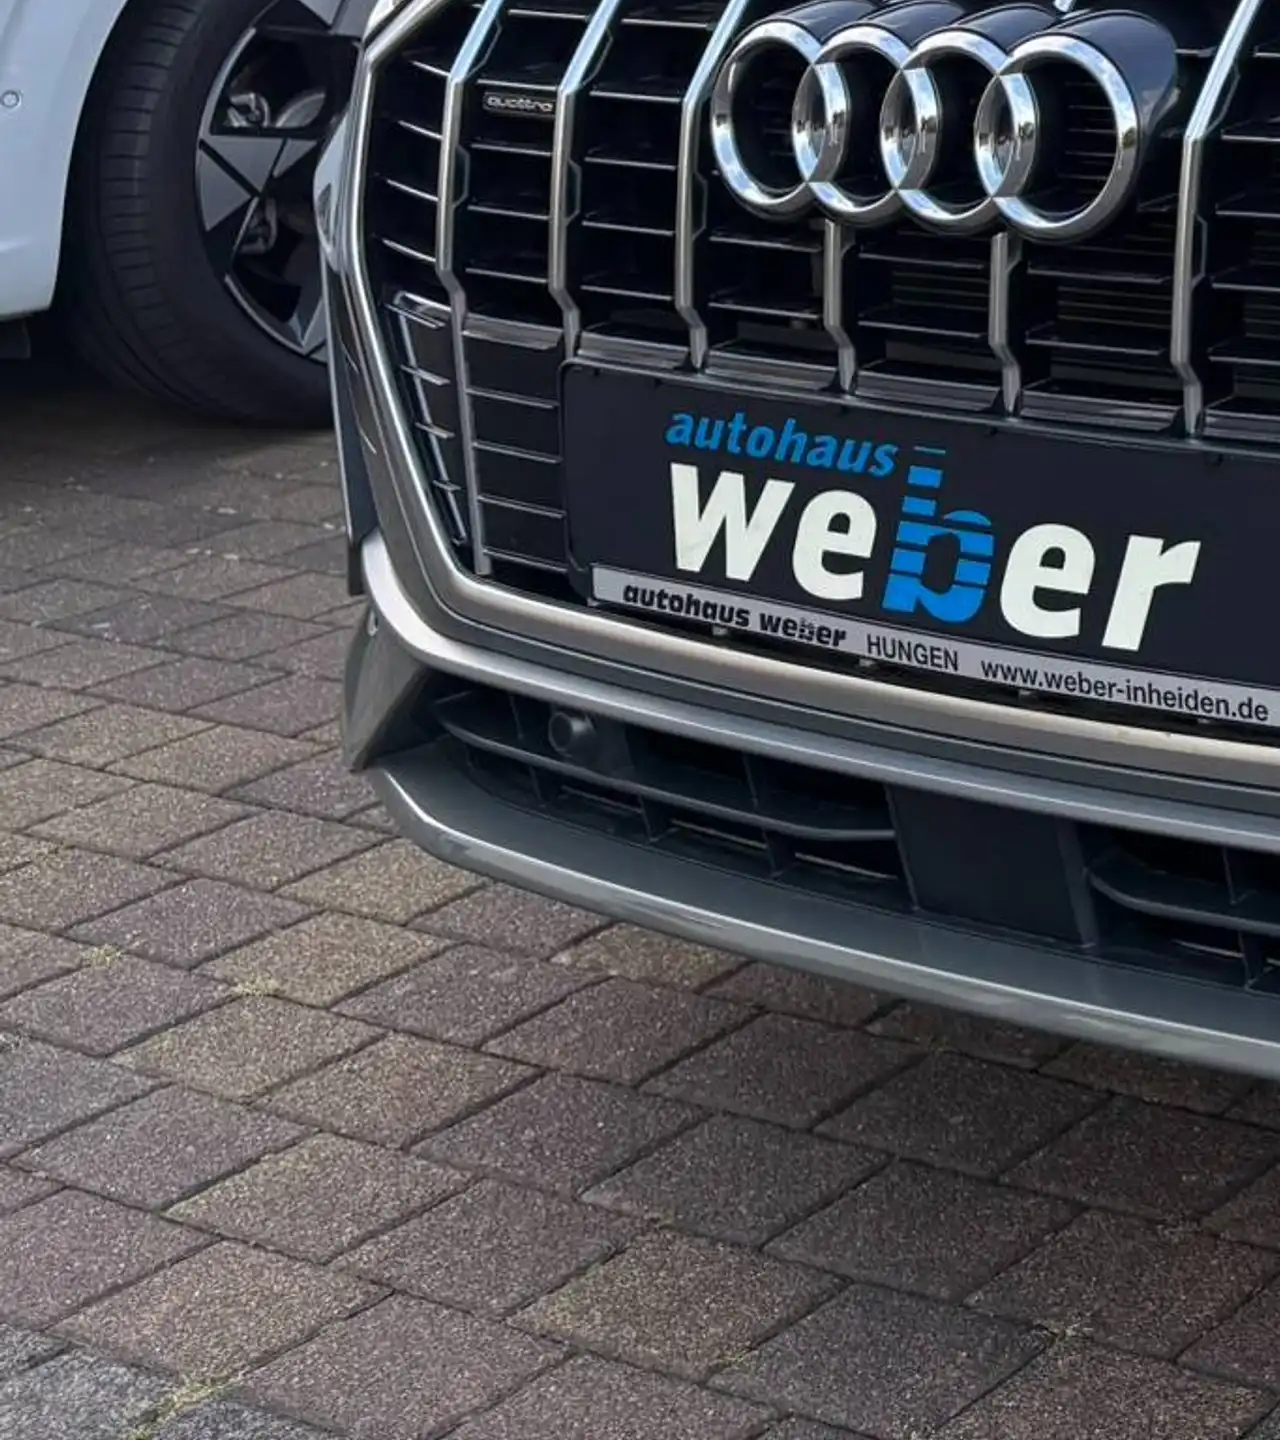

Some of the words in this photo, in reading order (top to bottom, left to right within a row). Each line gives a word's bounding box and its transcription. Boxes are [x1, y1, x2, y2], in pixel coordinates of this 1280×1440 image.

[486, 96, 554, 113] quattro
[666, 411, 899, 479] autohaus
[671, 445, 1201, 651] weber
[622, 582, 750, 628] autohaus
[759, 611, 848, 649] weber
[866, 632, 959, 672] HUNGEN
[980, 659, 1270, 722] www.weber-inheiden.de
